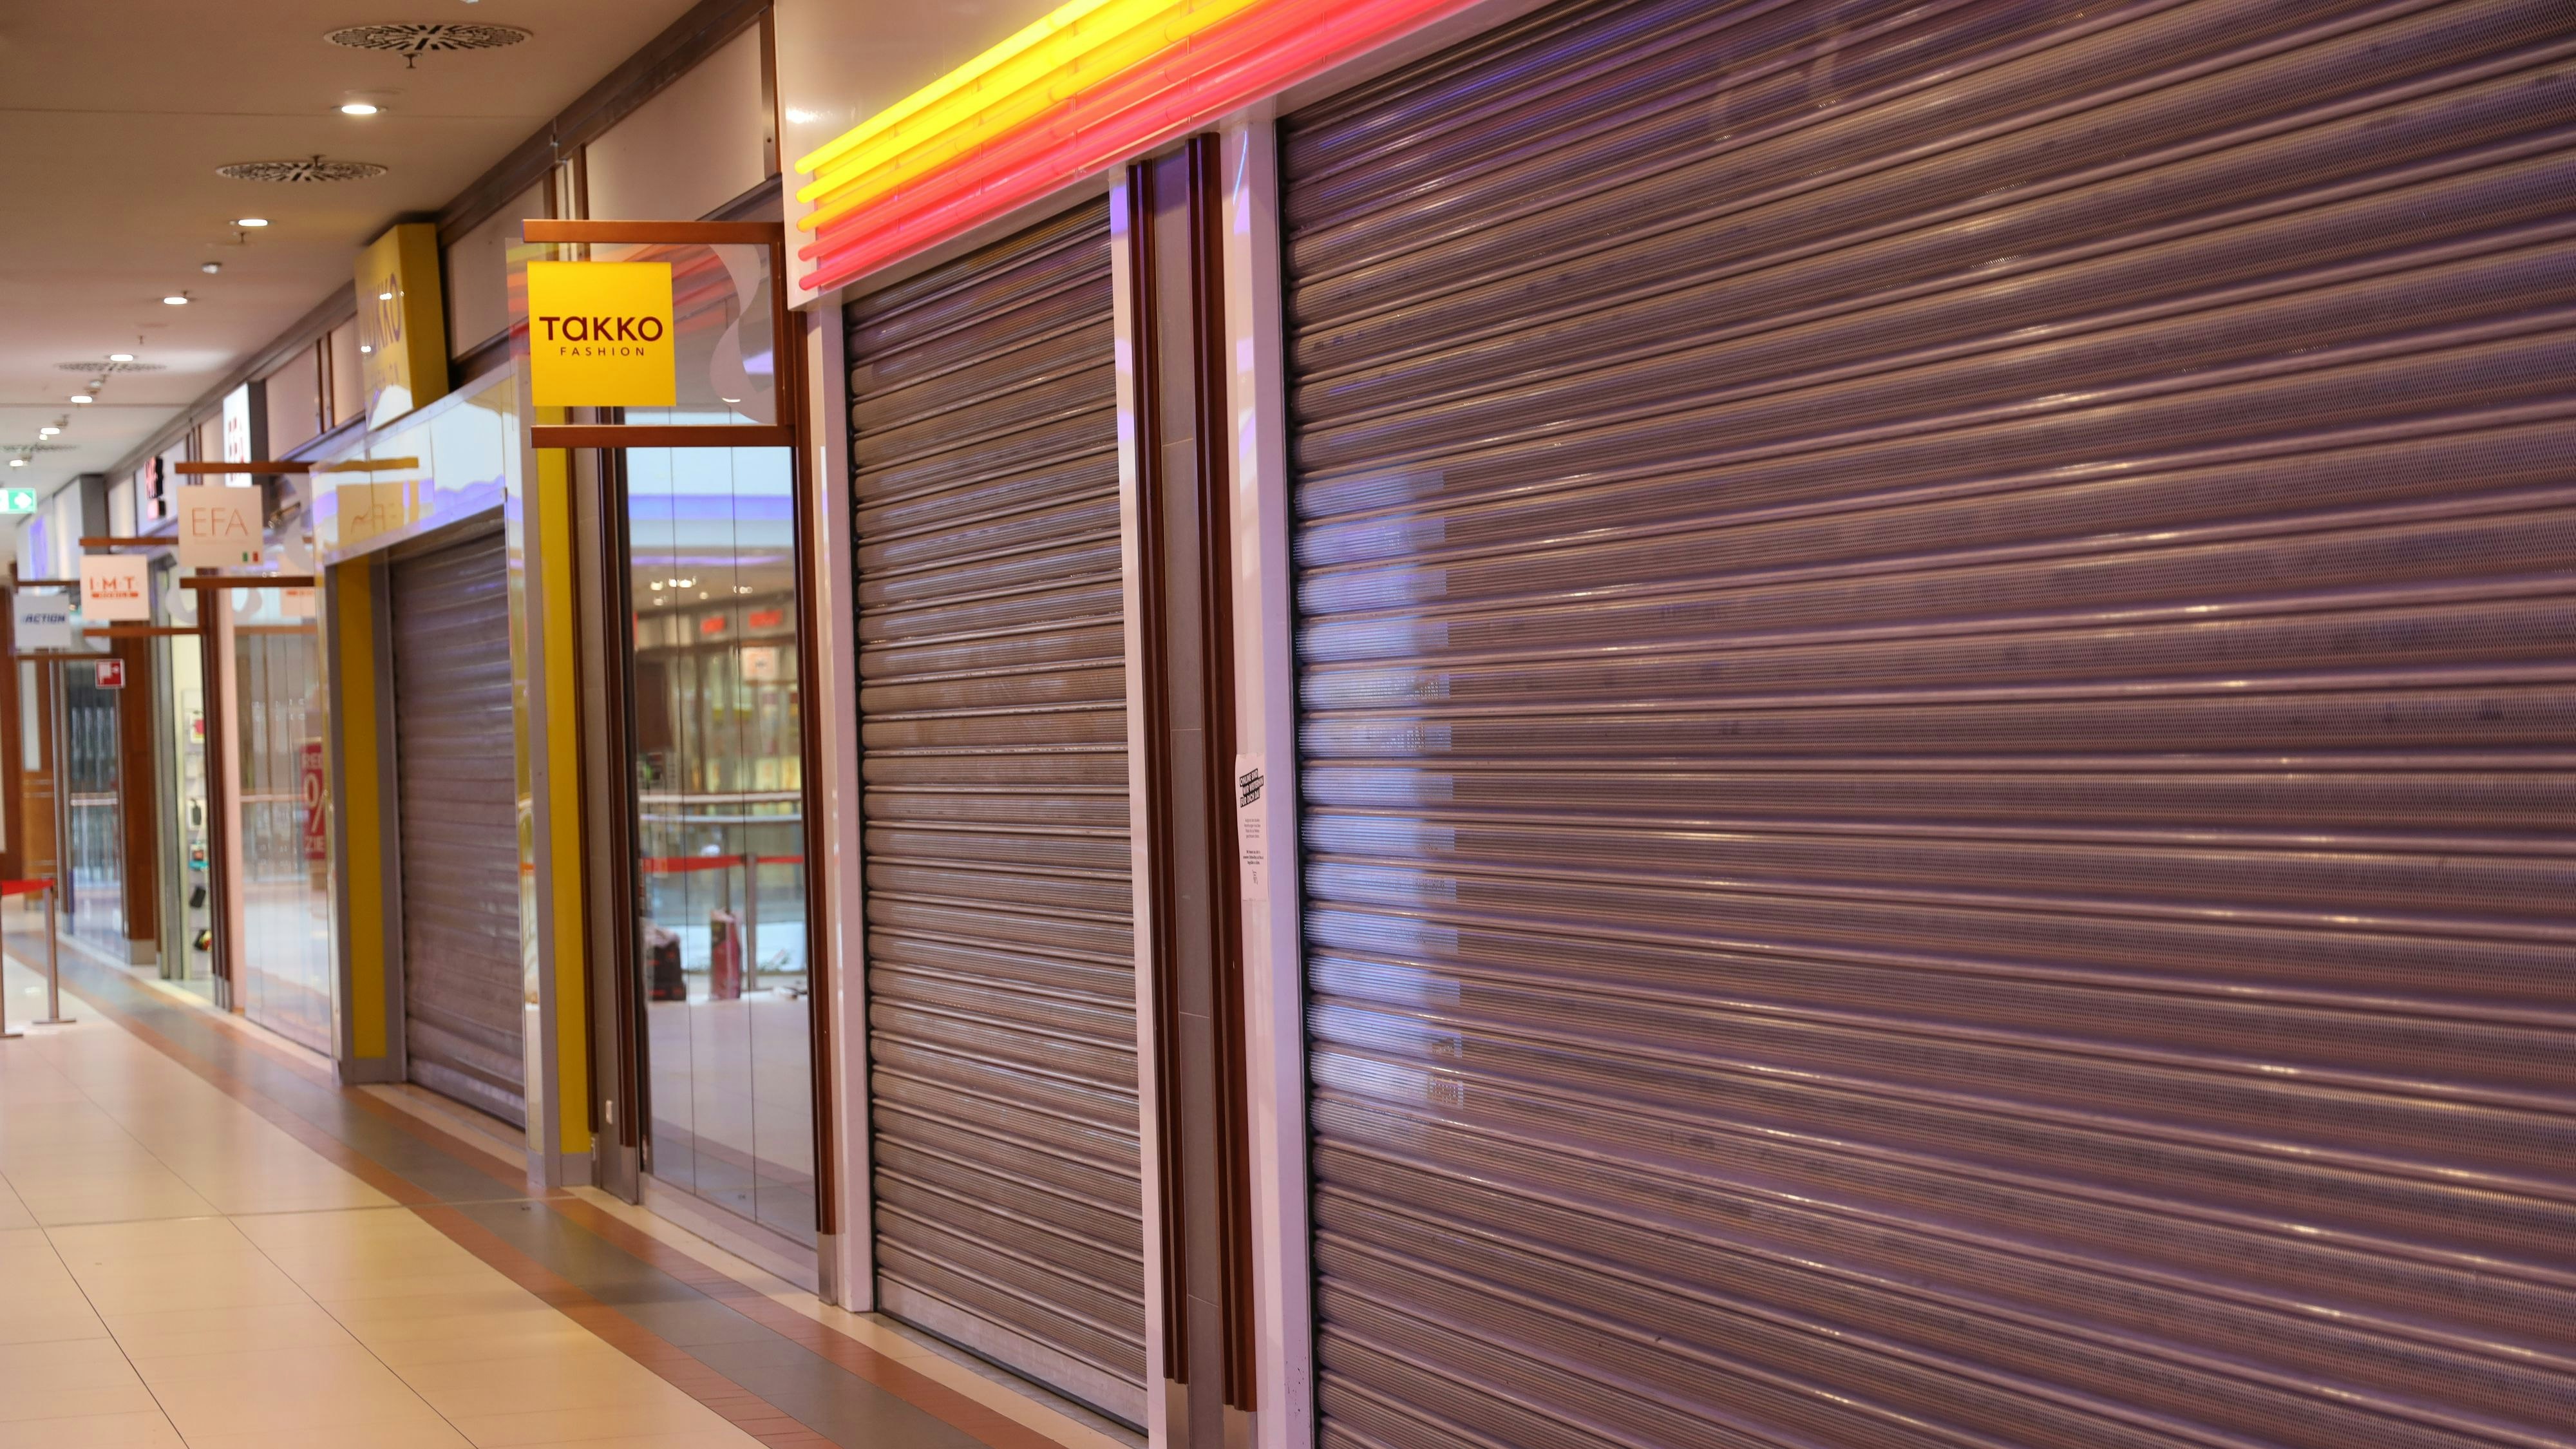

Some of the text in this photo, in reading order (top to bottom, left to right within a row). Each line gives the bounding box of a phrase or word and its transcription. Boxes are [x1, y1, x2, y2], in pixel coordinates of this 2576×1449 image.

[538, 316, 663, 342] TaKKO
[560, 346, 645, 357] FASHION
[192, 507, 249, 537] EFA
[24, 613, 66, 625] ACTION
